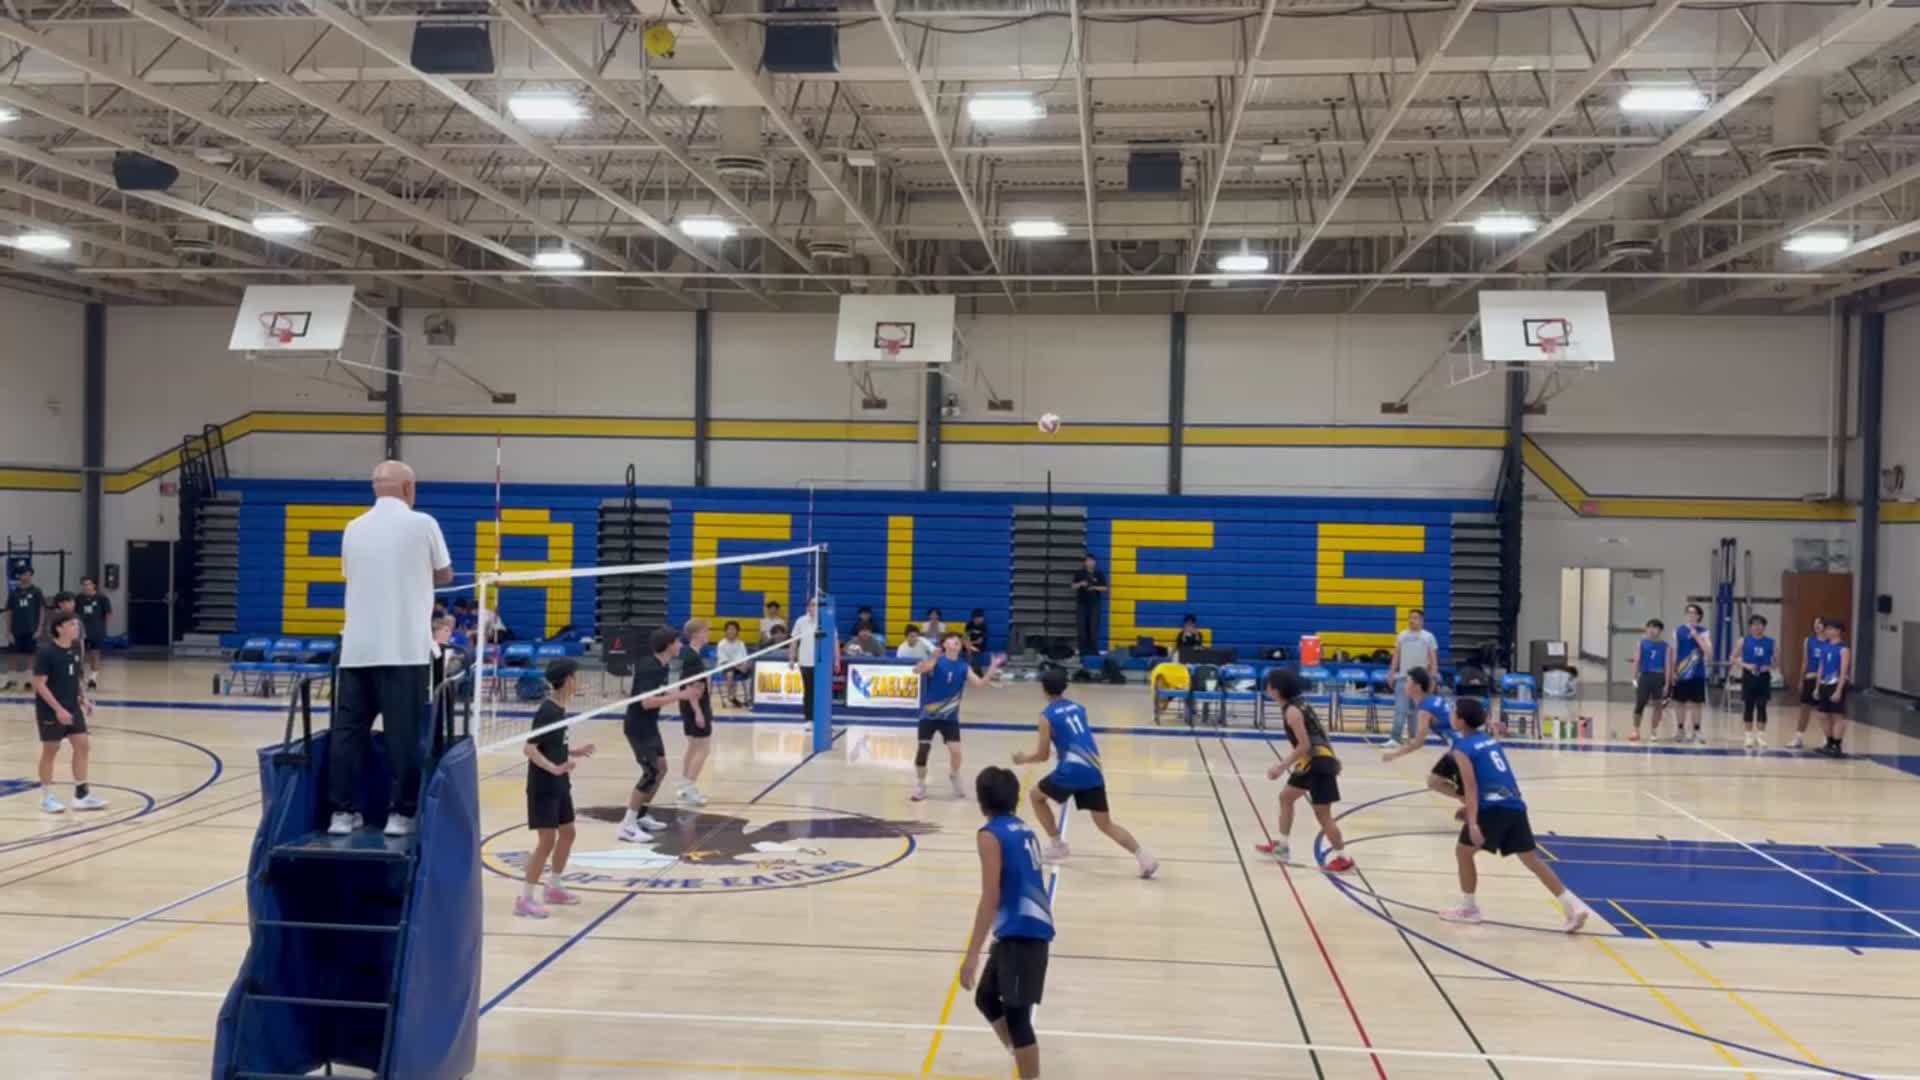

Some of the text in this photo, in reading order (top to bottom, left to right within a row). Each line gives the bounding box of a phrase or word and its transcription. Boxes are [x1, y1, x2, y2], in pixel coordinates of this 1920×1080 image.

[281, 502, 1426, 661] EAGLES
[1066, 714, 1085, 735] 11
[1489, 750, 1507, 772] 6
[625, 877, 703, 889] THE
[720, 860, 865, 887] EAGLES
